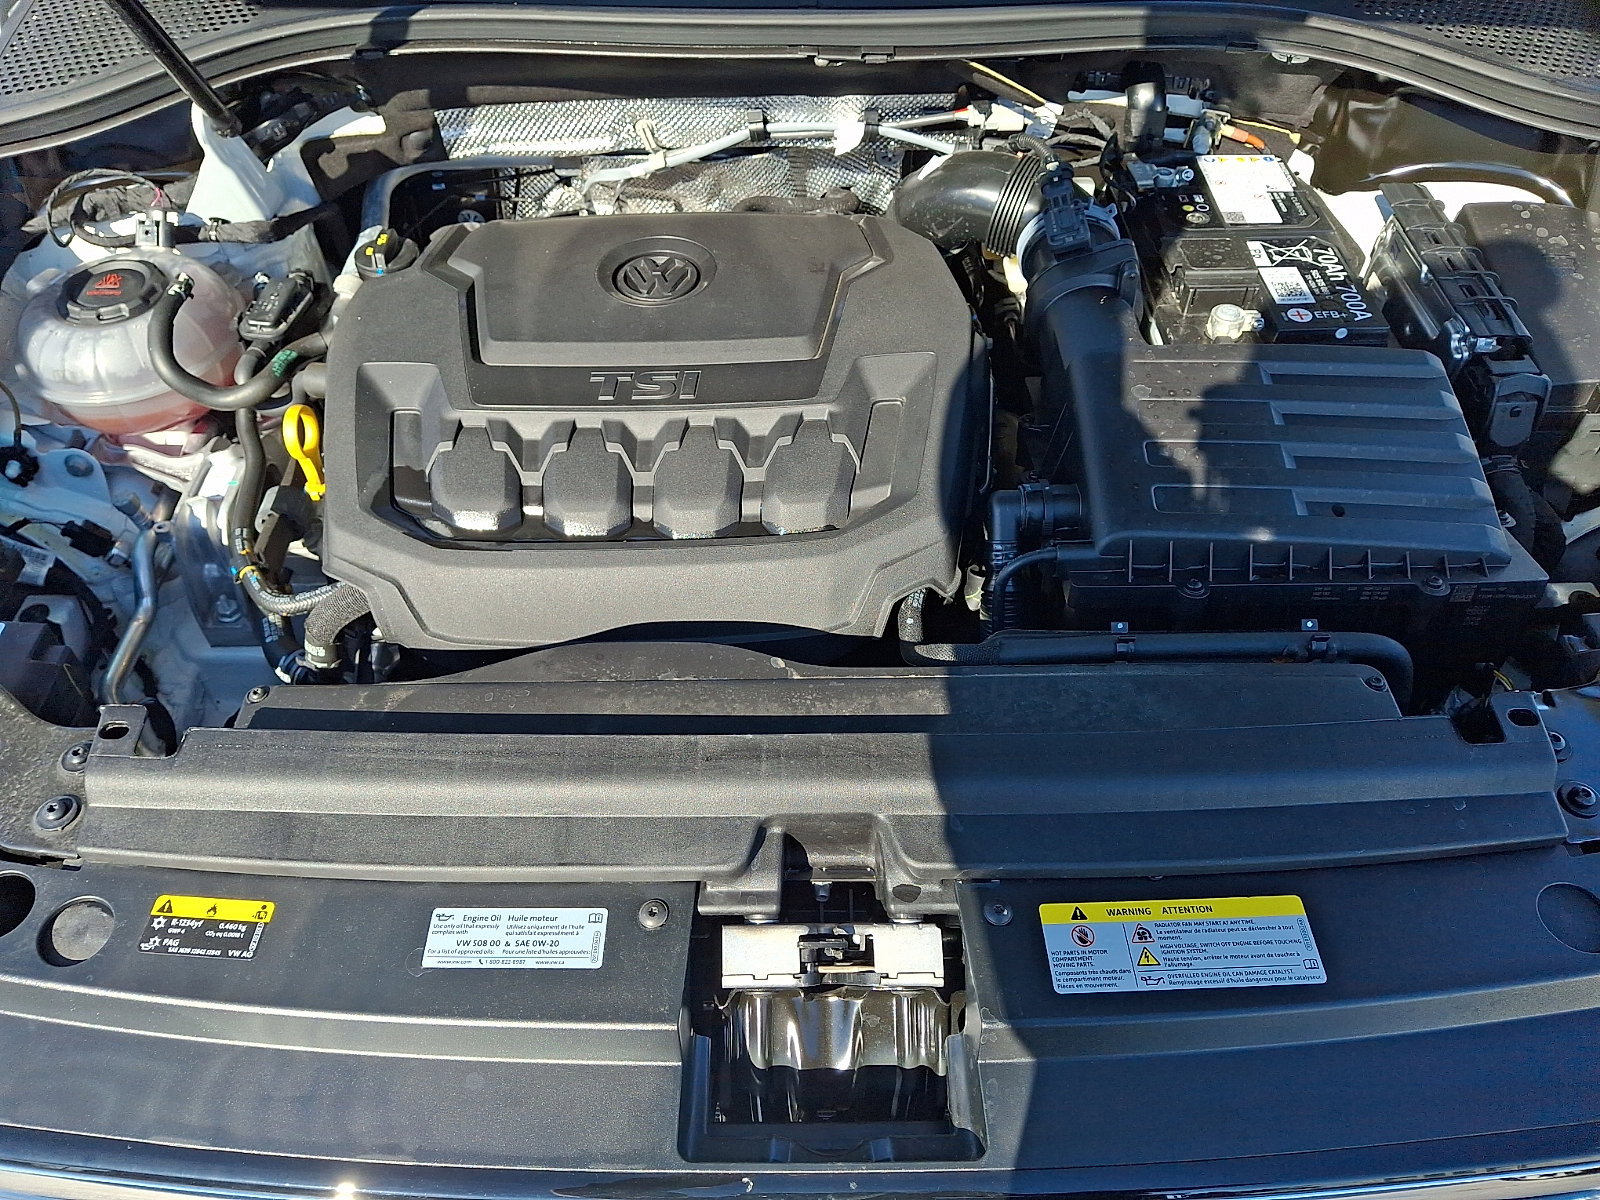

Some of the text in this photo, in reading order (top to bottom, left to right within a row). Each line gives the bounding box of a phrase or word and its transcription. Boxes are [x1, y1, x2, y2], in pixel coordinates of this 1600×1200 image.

[1313, 248, 1372, 321] 70Ah 700A
[1314, 310, 1348, 319] EFB+
[590, 371, 701, 400] TSI
[1106, 905, 1213, 916] WARNING ATTENTION
[463, 915, 488, 923] Engine
[238, 924, 247, 932] kg
